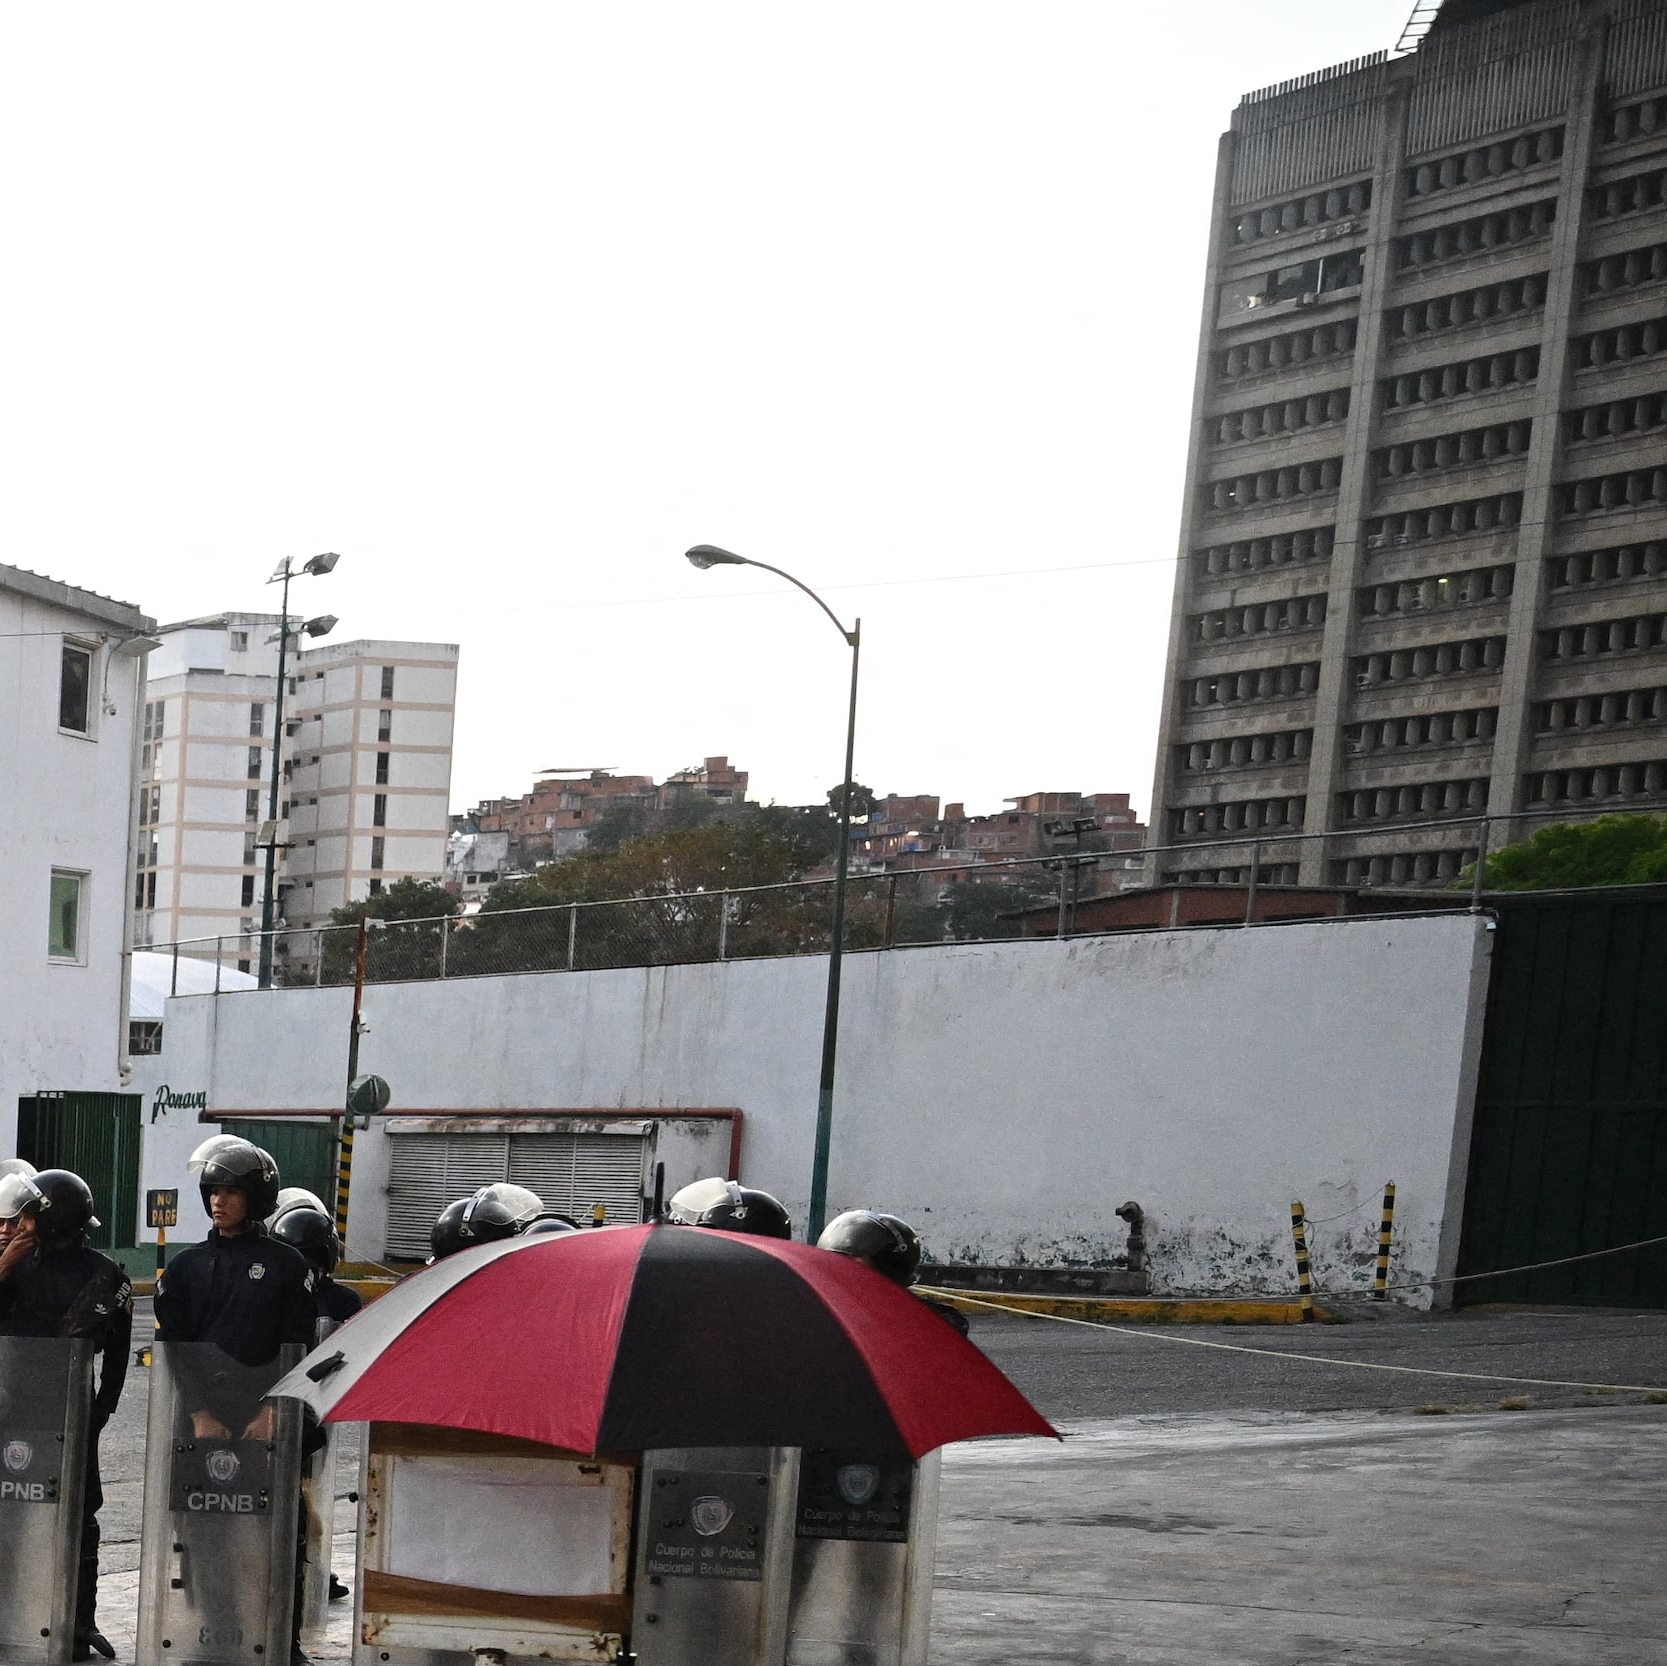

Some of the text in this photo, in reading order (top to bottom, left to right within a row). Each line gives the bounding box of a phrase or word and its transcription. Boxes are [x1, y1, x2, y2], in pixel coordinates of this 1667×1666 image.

[156, 1193, 172, 1207] NO
[152, 1209, 177, 1225] PARE
[187, 1492, 254, 1514] CPNB
[654, 1543, 695, 1561] Cuerpo
[700, 1545, 715, 1558] de
[648, 1561, 694, 1575] Nacional
